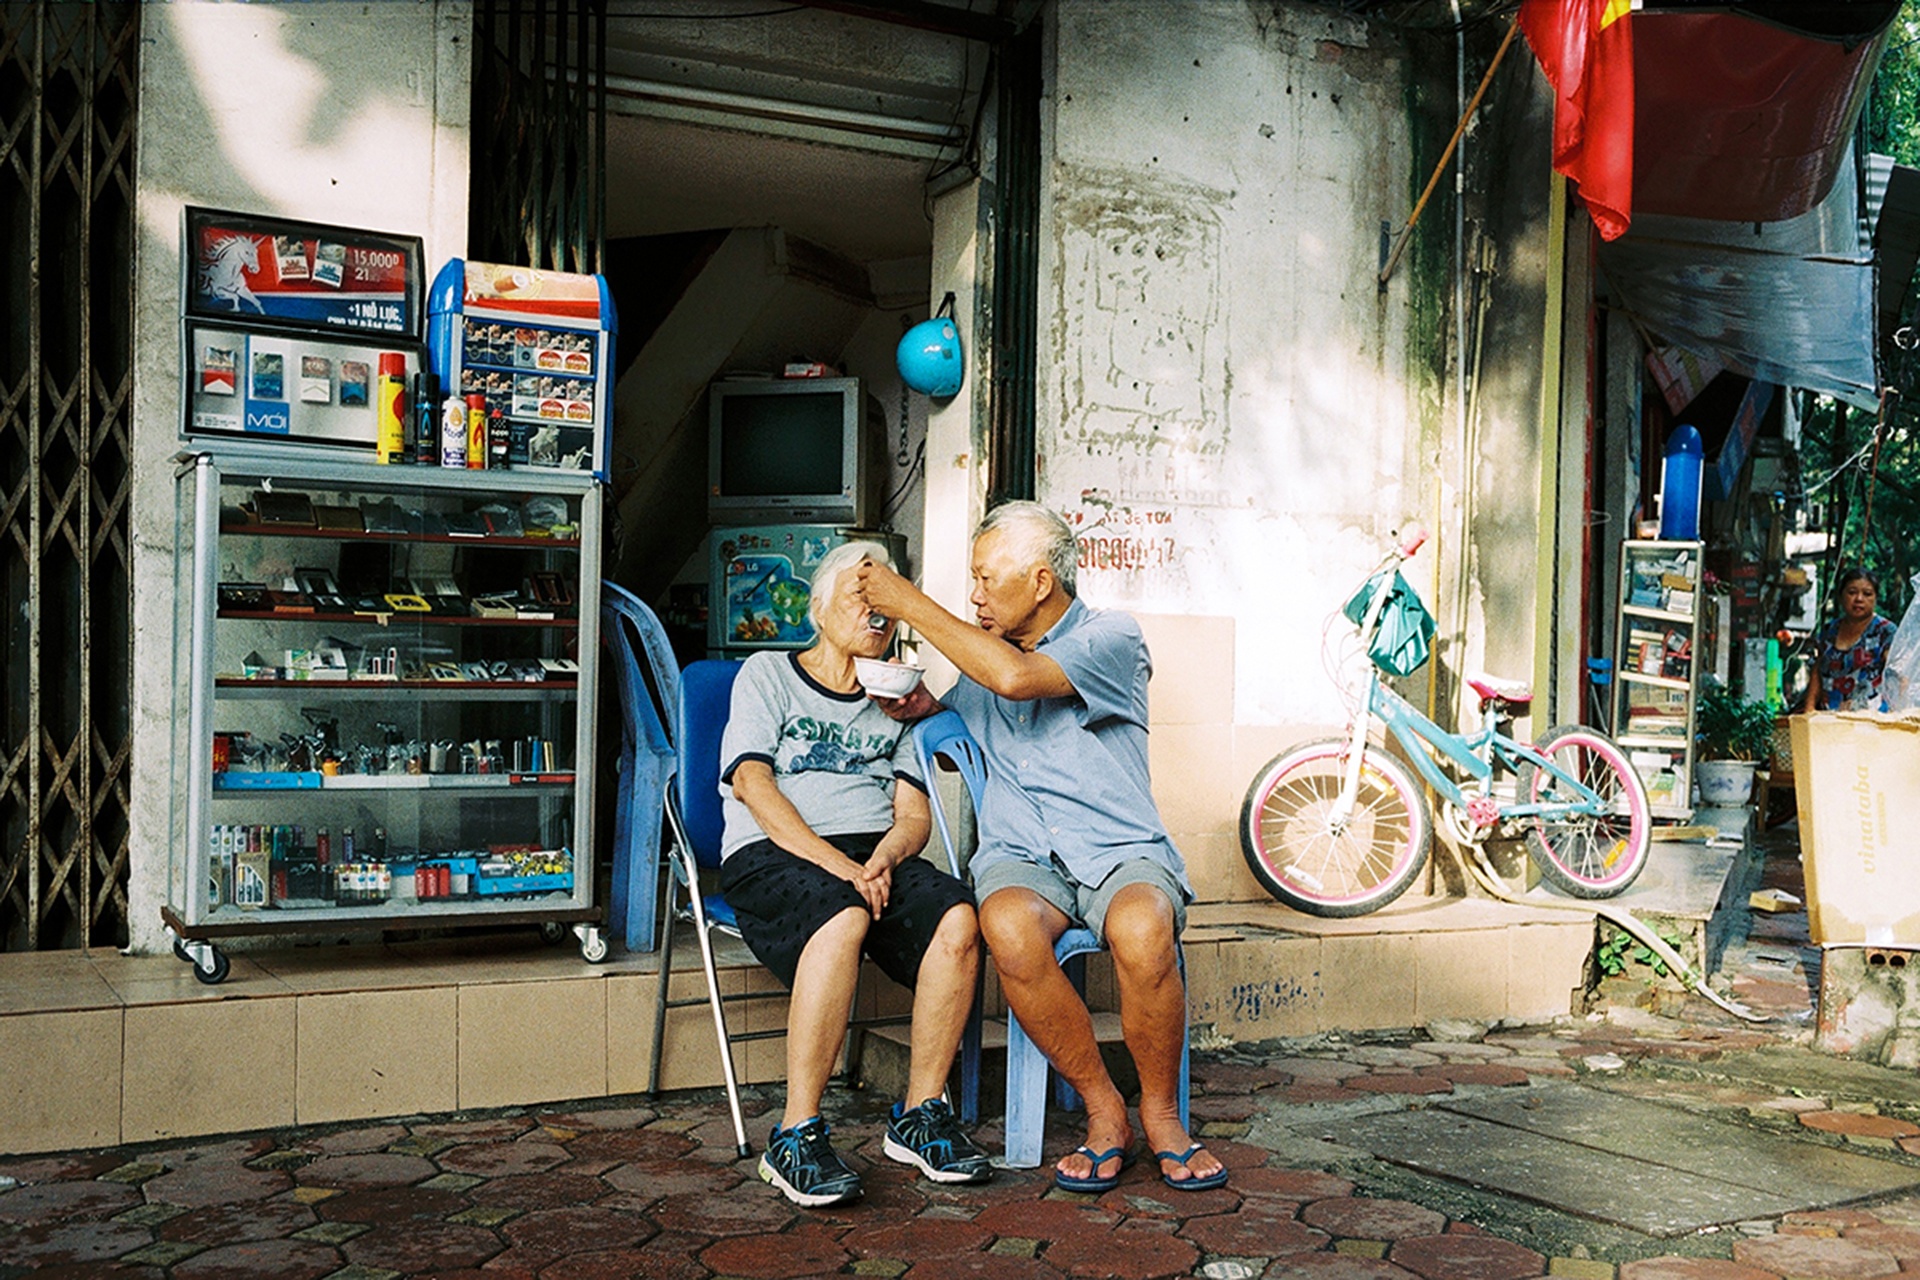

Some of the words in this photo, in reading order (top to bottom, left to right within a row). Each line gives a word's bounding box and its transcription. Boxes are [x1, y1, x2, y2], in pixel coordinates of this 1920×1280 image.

[355, 267, 370, 281] 21
[747, 563, 758, 571] LG
[1852, 766, 1876, 873] vinataba
